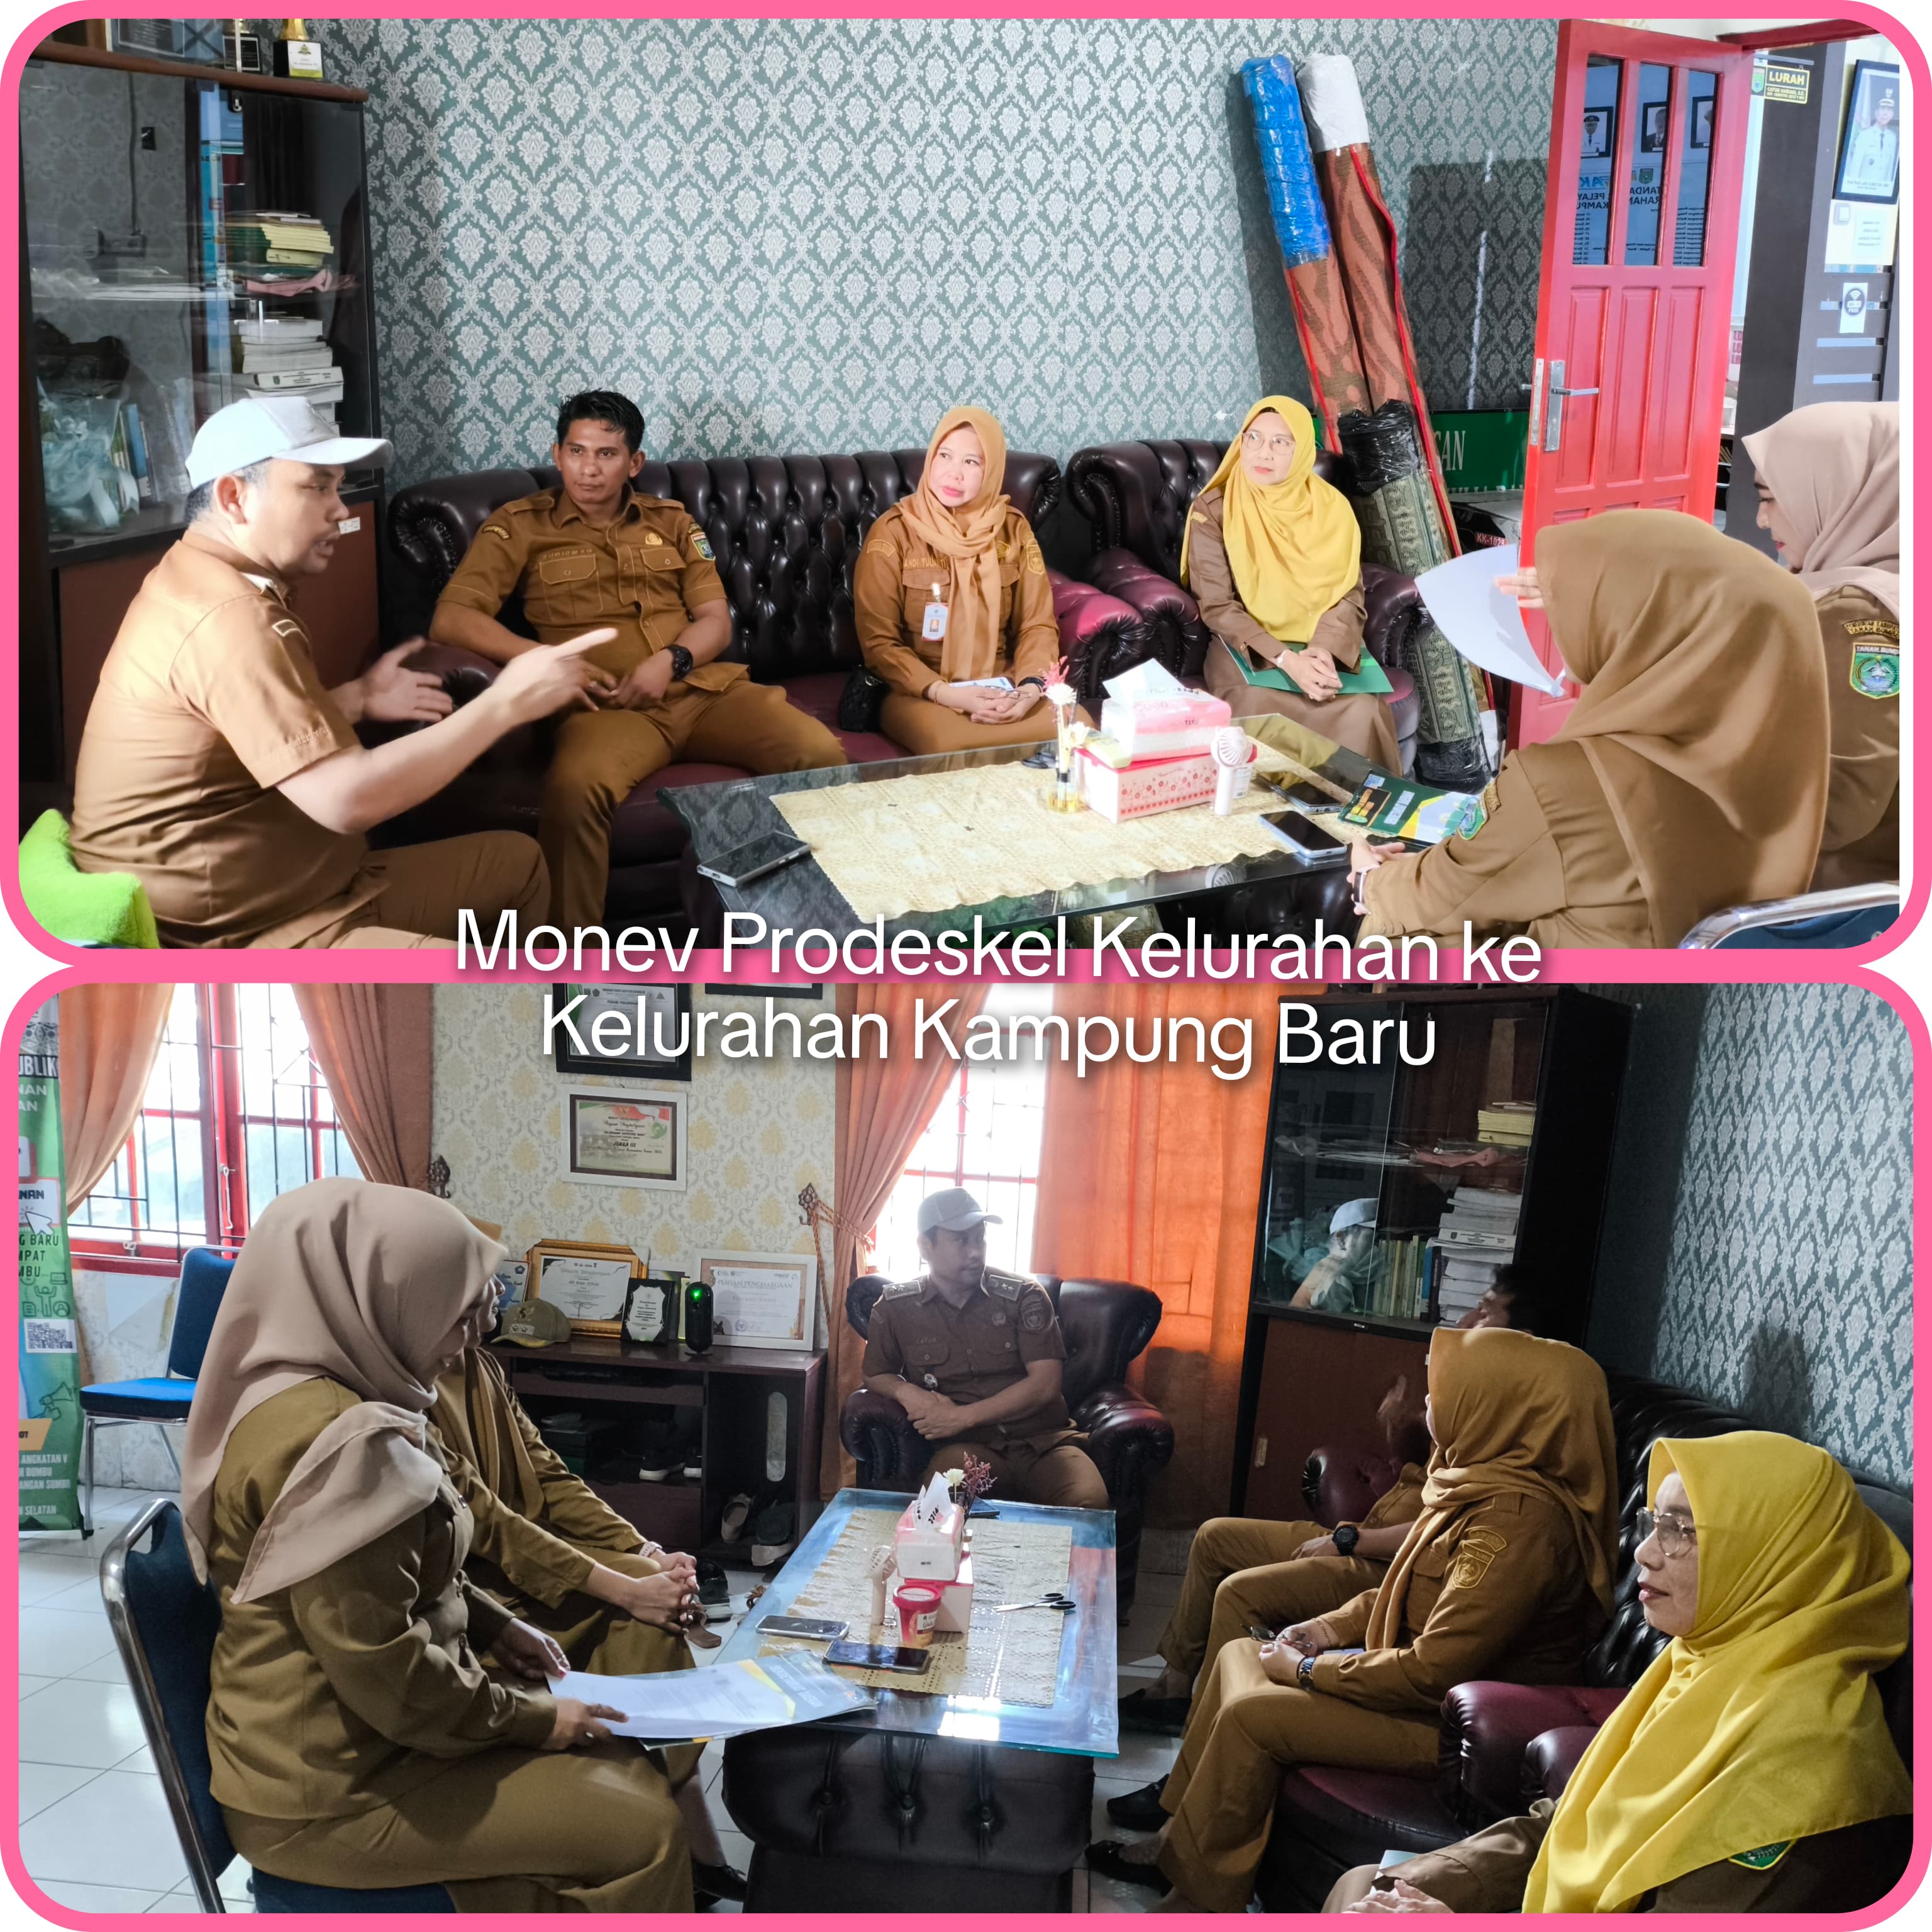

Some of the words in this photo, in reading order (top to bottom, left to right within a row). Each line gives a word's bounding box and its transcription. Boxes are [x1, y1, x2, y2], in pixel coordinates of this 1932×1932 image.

[1769, 70, 1805, 86] LURAH
[30, 1234, 59, 1246] BARU
[21, 1454, 61, 1464] ANGKATAN
[25, 1505, 57, 1516] SELATAN
